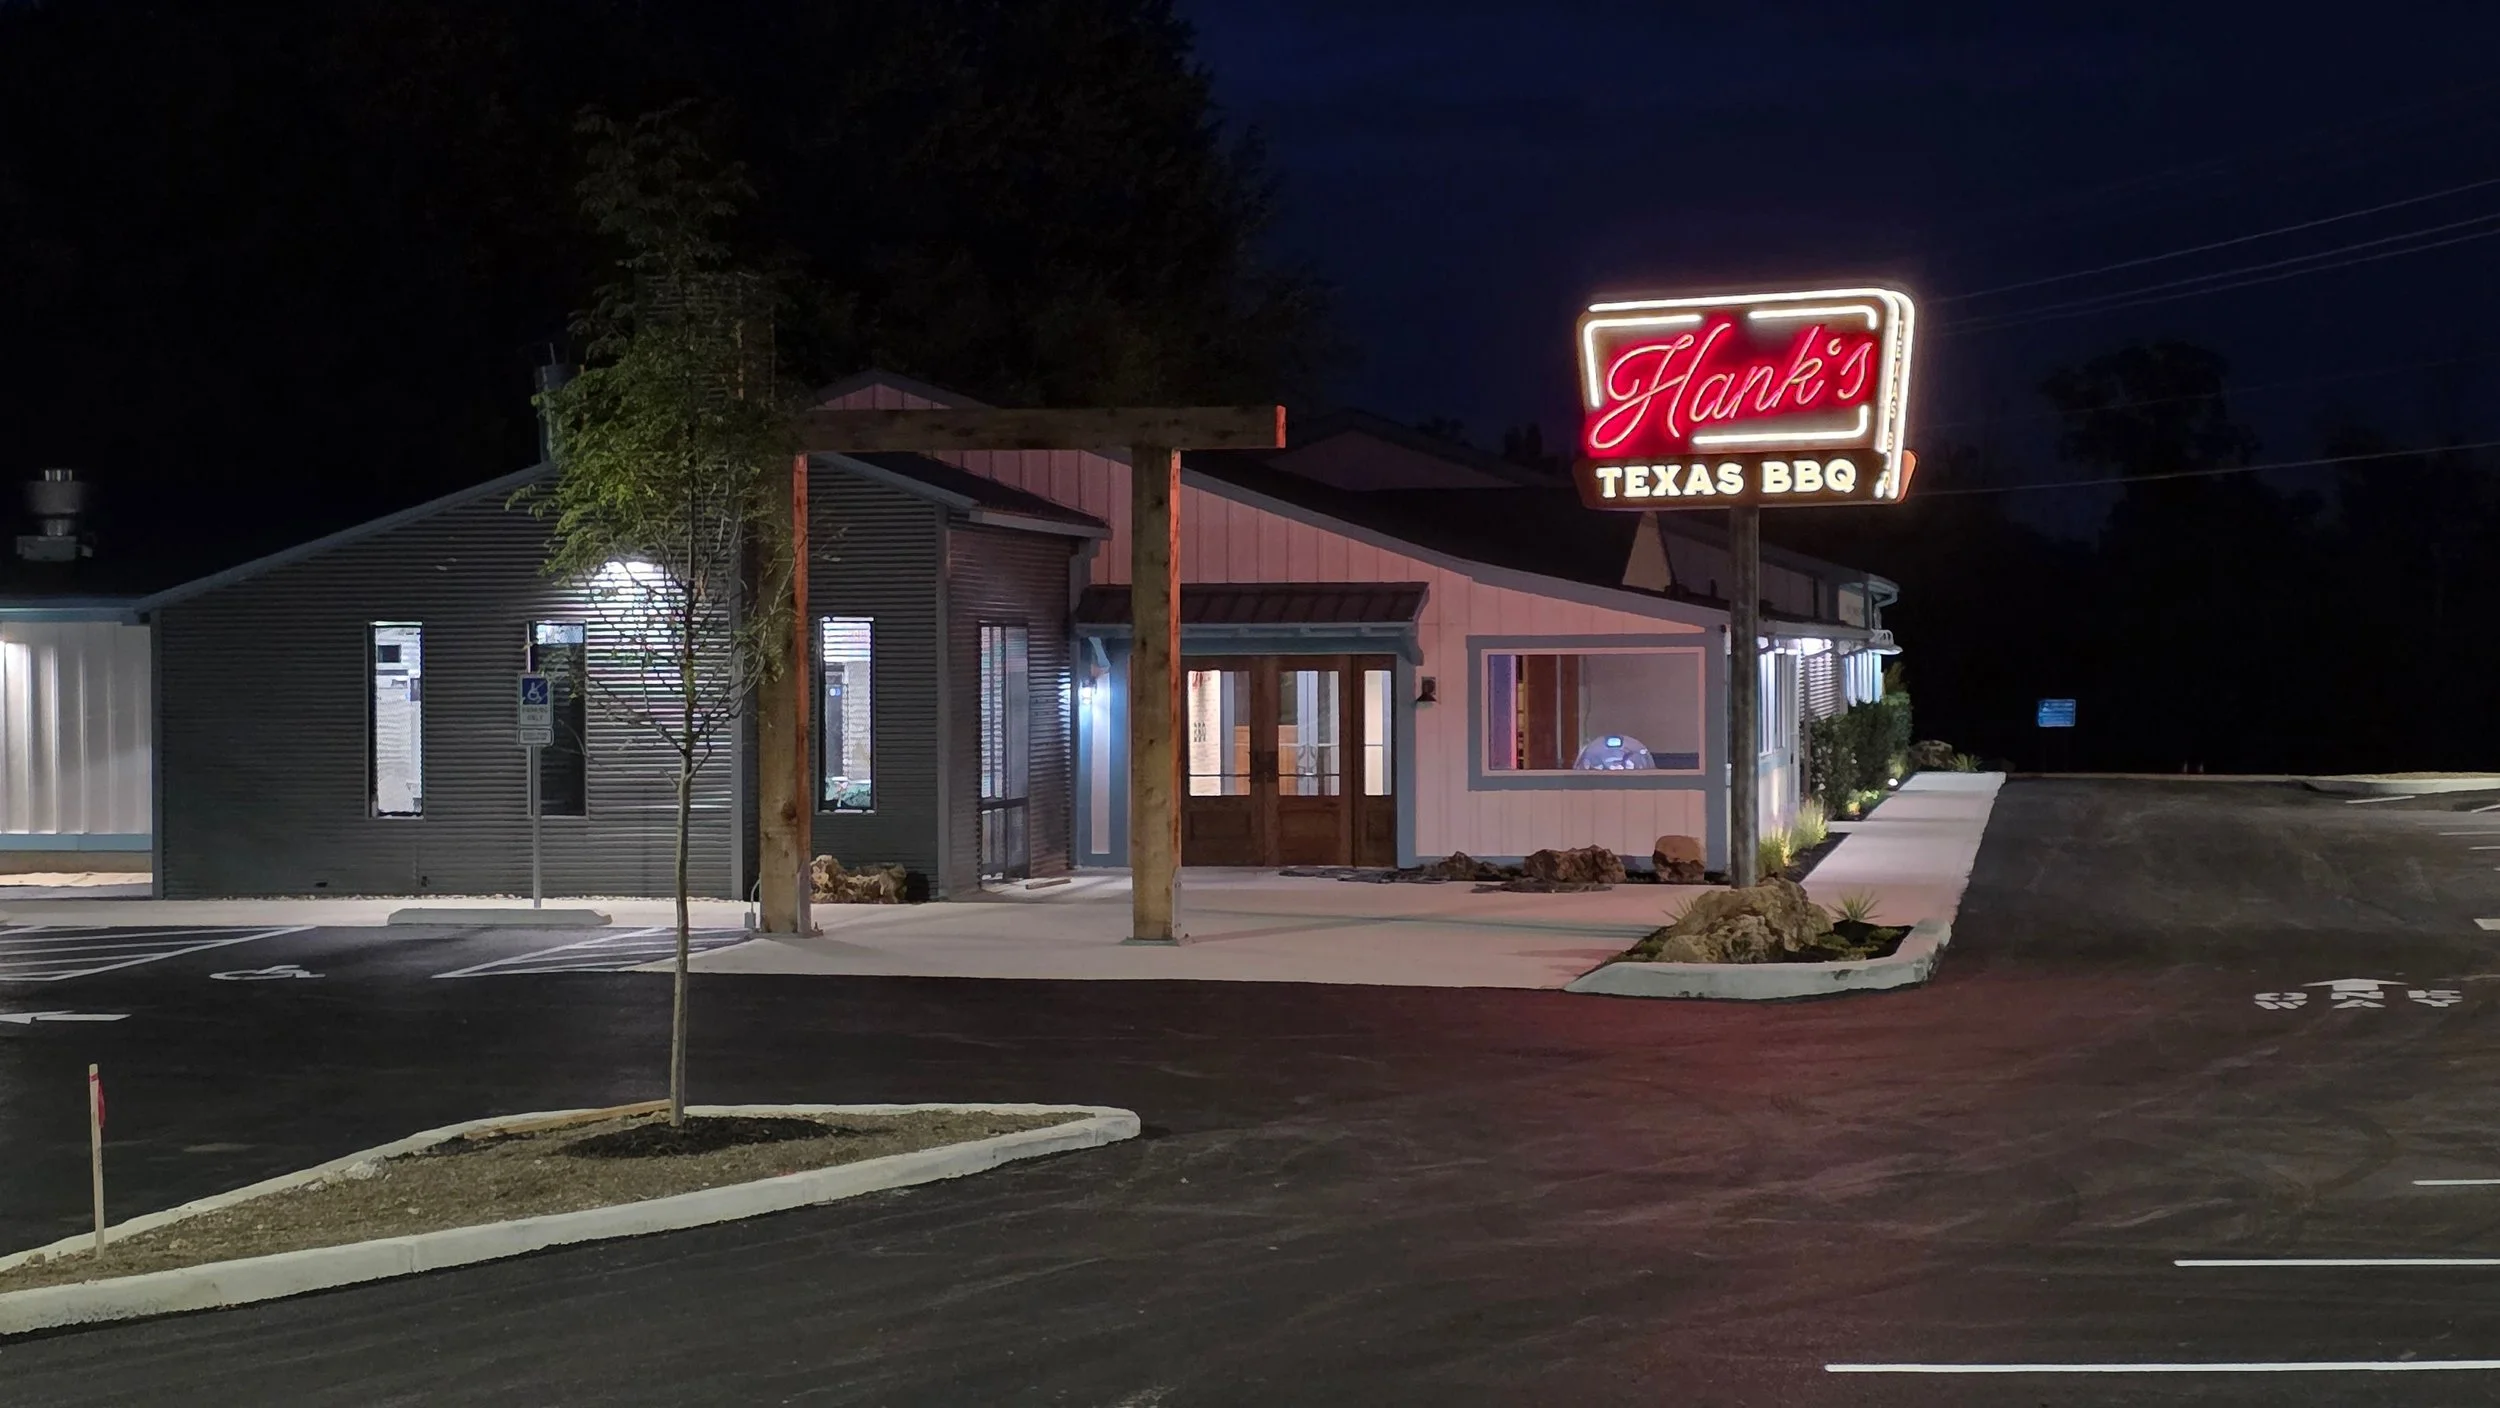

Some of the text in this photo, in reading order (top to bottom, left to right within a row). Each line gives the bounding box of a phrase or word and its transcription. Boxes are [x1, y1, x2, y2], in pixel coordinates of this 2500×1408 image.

[1590, 322, 1873, 449] Hank's
[1596, 462, 1745, 498] TEXAS
[1760, 458, 1857, 495] BBQ
[2254, 990, 2463, 1001] ONE
[2254, 999, 2463, 1010] WAY
